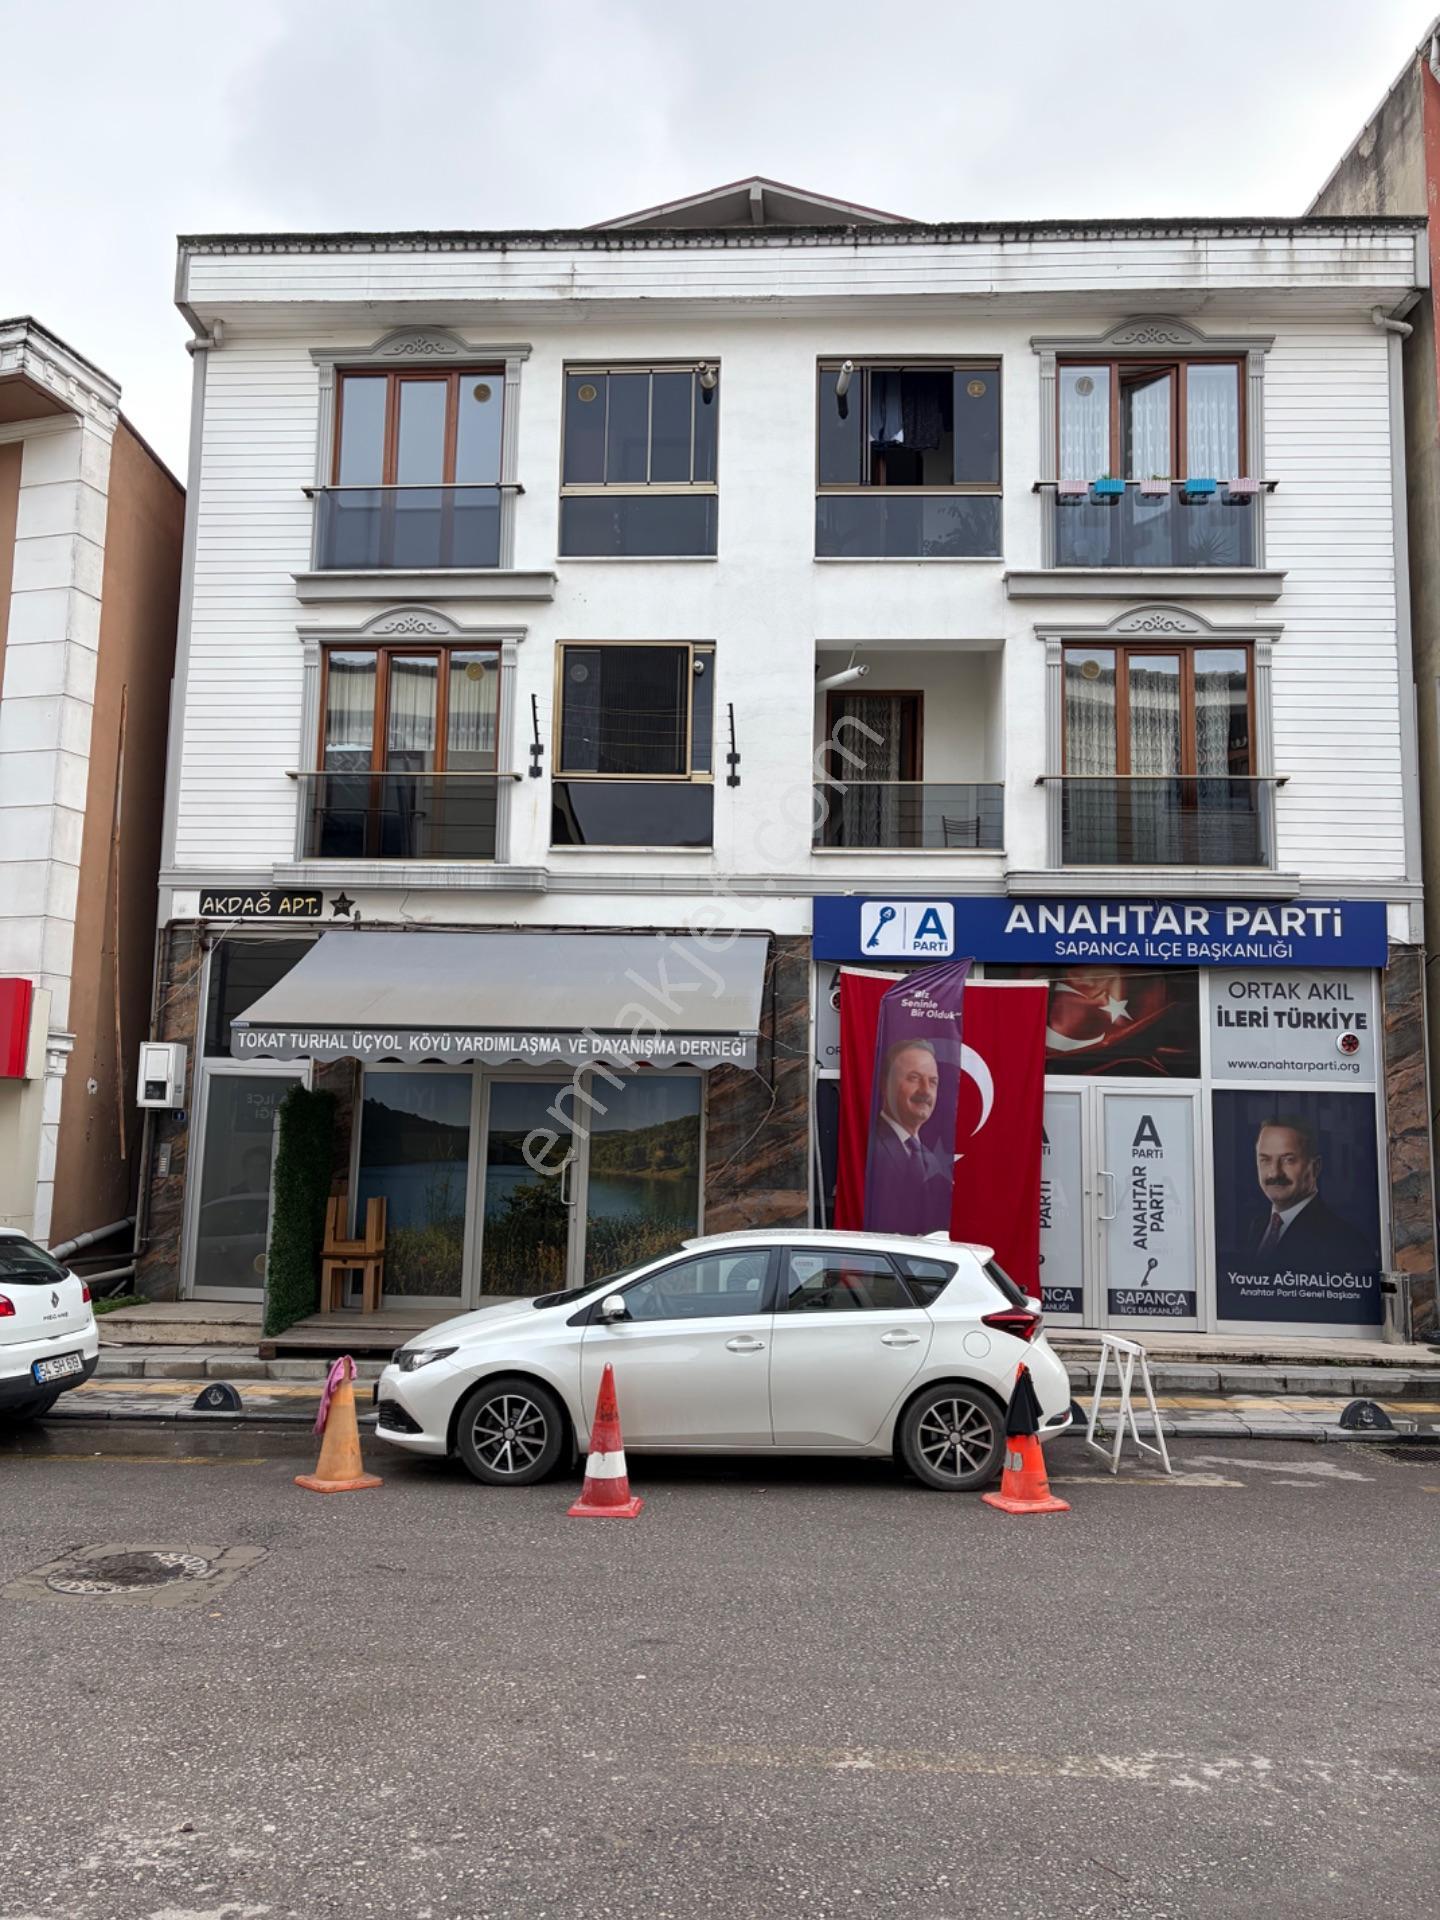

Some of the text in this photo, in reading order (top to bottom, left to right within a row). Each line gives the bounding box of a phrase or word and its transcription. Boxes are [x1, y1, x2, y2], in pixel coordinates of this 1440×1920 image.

[201, 891, 318, 914] AKDAĞ APT.
[914, 907, 947, 940] A
[1004, 905, 1210, 935] ANAHTAR
[1055, 939, 1293, 961] SAPANCA İLÇE BAŞKANLIĞI
[1228, 981, 1355, 1001] ORTAK AKIL
[901, 998, 938, 1010] Seninle
[910, 1008, 925, 1018] Bir
[1217, 1004, 1368, 1030] İLERİ TÜRKİYE
[238, 1031, 746, 1057] TOKAT TURHAL ÜÇYOL KÖYÜ YARDIMLAŞMA VE DAYANIŞMA DERNEĞİ
[1228, 1058, 1360, 1074] www.anahtarparti.org
[1132, 1115, 1162, 1148] A
[1132, 1165, 1147, 1250] ANAHTAR
[1228, 1270, 1373, 1289] Yavuz AĞIRALİOĞLU
[1115, 1290, 1188, 1306] SAPANCA
[1240, 1287, 1275, 1297] Anahtar
[1277, 1288, 1297, 1298] Parti
[1299, 1289, 1325, 1299] Genel
[1138, 1305, 1183, 1316] BAŞKANLIĞI
